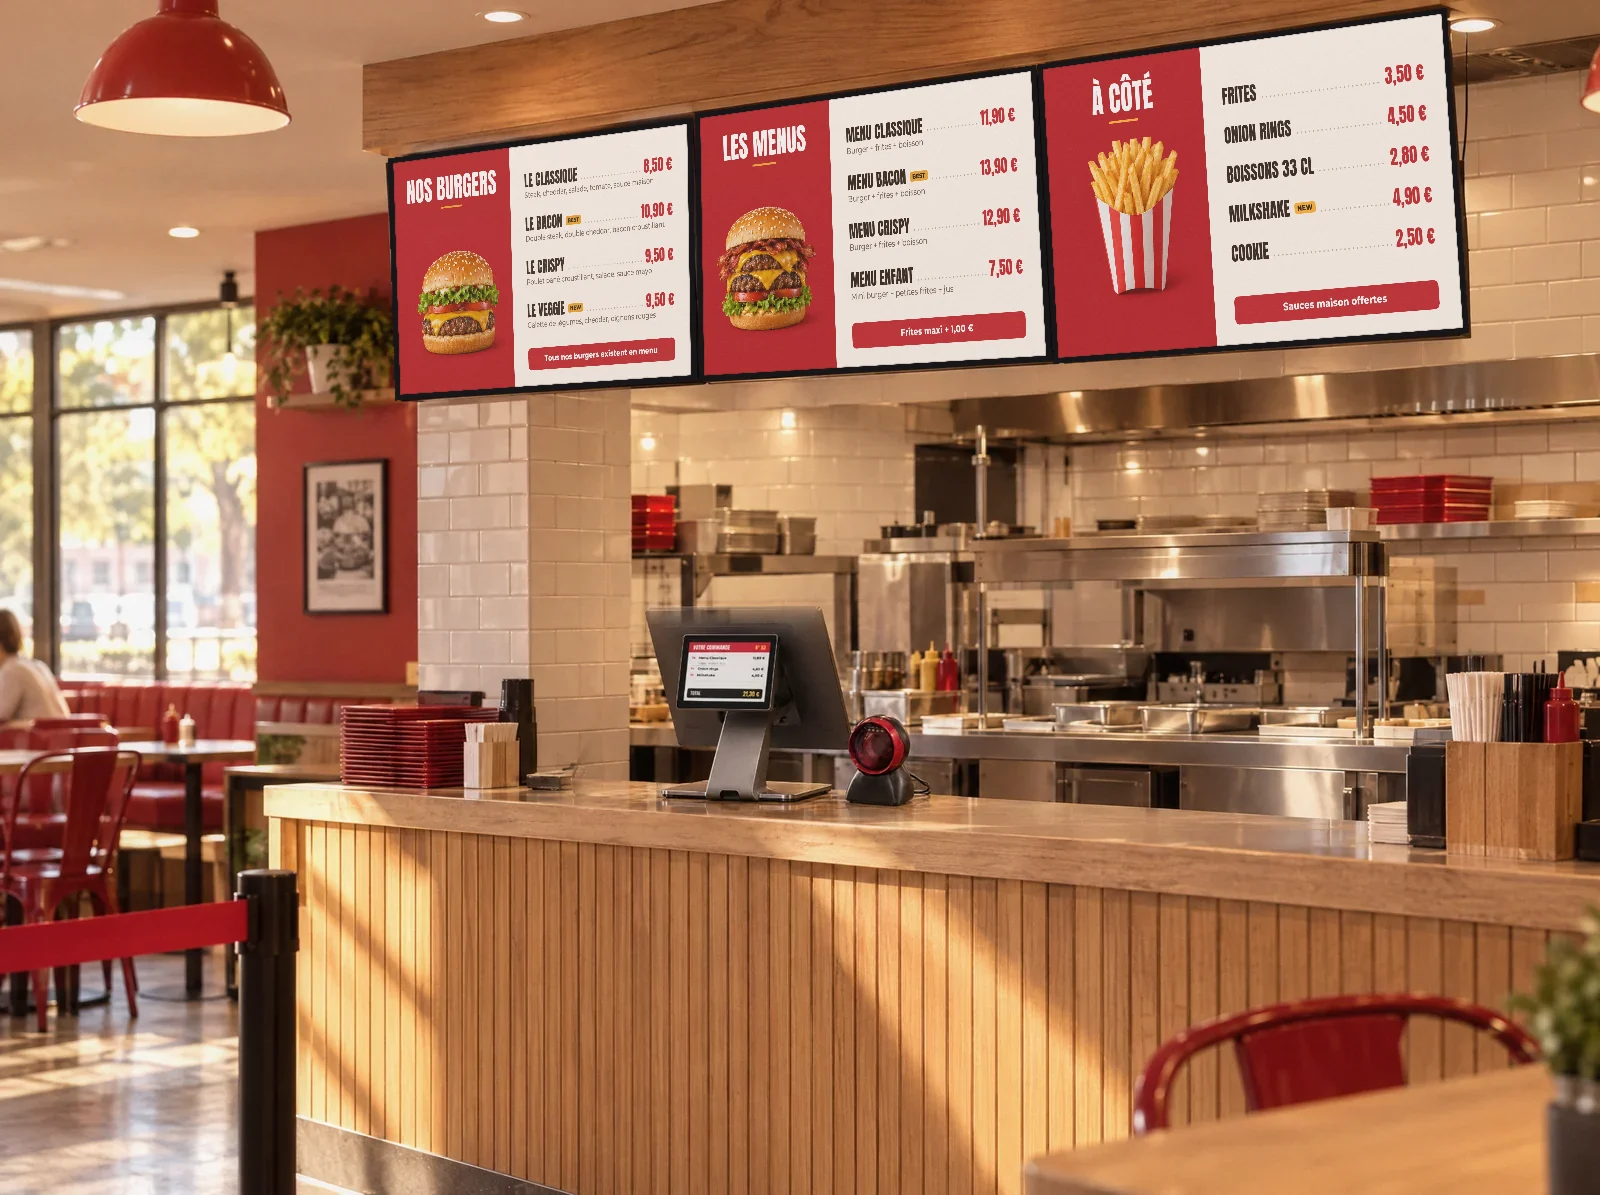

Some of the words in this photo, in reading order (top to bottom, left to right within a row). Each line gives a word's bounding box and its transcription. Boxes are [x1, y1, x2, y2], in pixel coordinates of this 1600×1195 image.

[1092, 78, 1104, 115] À
[1109, 71, 1153, 113] CÔTÉ
[1222, 84, 1256, 105] FRITES
[1385, 64, 1412, 86] 3,50
[1416, 64, 1424, 80] €
[846, 125, 871, 143] MENU
[874, 118, 922, 139] CLASSIQUE
[980, 107, 1005, 126] 11,90
[1008, 108, 1016, 122] €
[1224, 124, 1256, 144] ONION
[1259, 120, 1291, 140] RINGS
[1388, 105, 1414, 126] 4,50
[1418, 104, 1426, 121] €
[723, 133, 748, 161] LES
[753, 125, 806, 158] MENUS
[524, 173, 533, 188] LE
[536, 167, 577, 186] CLASSIQUE
[644, 157, 663, 174] 8,50
[666, 157, 672, 170] €
[848, 173, 873, 190] MENU
[876, 169, 906, 187] BACON
[980, 157, 1007, 176] 13,90
[1011, 158, 1018, 172] €
[1227, 161, 1279, 183] BOISSONS
[1282, 159, 1297, 177] 33
[1301, 157, 1314, 175] CL
[1390, 145, 1417, 167] 2,80
[1421, 146, 1429, 162] €
[407, 178, 432, 204] NOS
[437, 170, 496, 200] BURGERS
[525, 216, 534, 231] LE
[536, 214, 562, 230] BACON
[640, 202, 664, 219] 10,90
[667, 202, 673, 215] €
[1229, 200, 1290, 223] MILKSHAKE
[1392, 186, 1420, 208] 4,90
[1424, 186, 1432, 203] €
[564, 230, 584, 238] double
[849, 221, 875, 239] MENU
[878, 218, 909, 236] CRISPY
[982, 208, 1010, 227] 12,90
[1013, 208, 1020, 222] €
[1232, 242, 1269, 262] COOKIE
[1396, 227, 1423, 249] 2,50
[1426, 228, 1435, 244] €
[526, 260, 535, 274] LE
[538, 257, 564, 273] CRISPY
[645, 247, 665, 264] 9,50
[668, 248, 674, 260] €
[851, 270, 876, 288] MENU
[880, 267, 913, 285] ENFANT
[989, 259, 1012, 278] 7,50
[1016, 259, 1023, 274] €
[527, 304, 536, 318] LE
[538, 301, 565, 316] VEGGIE
[646, 292, 665, 309] 9,50
[668, 292, 674, 305] €
[866, 292, 888, 300] burger
[920, 286, 936, 294] frites
[943, 285, 954, 294] jus
[1283, 302, 1314, 311] Sauces
[1317, 298, 1349, 308] maison
[1352, 296, 1387, 305] offertes
[636, 312, 656, 320] rouges
[900, 327, 922, 336] Frites
[924, 325, 942, 334] maxi
[951, 324, 966, 334] 1,00
[968, 324, 974, 332] €
[574, 352, 600, 360] burgers
[600, 349, 627, 358] existent
